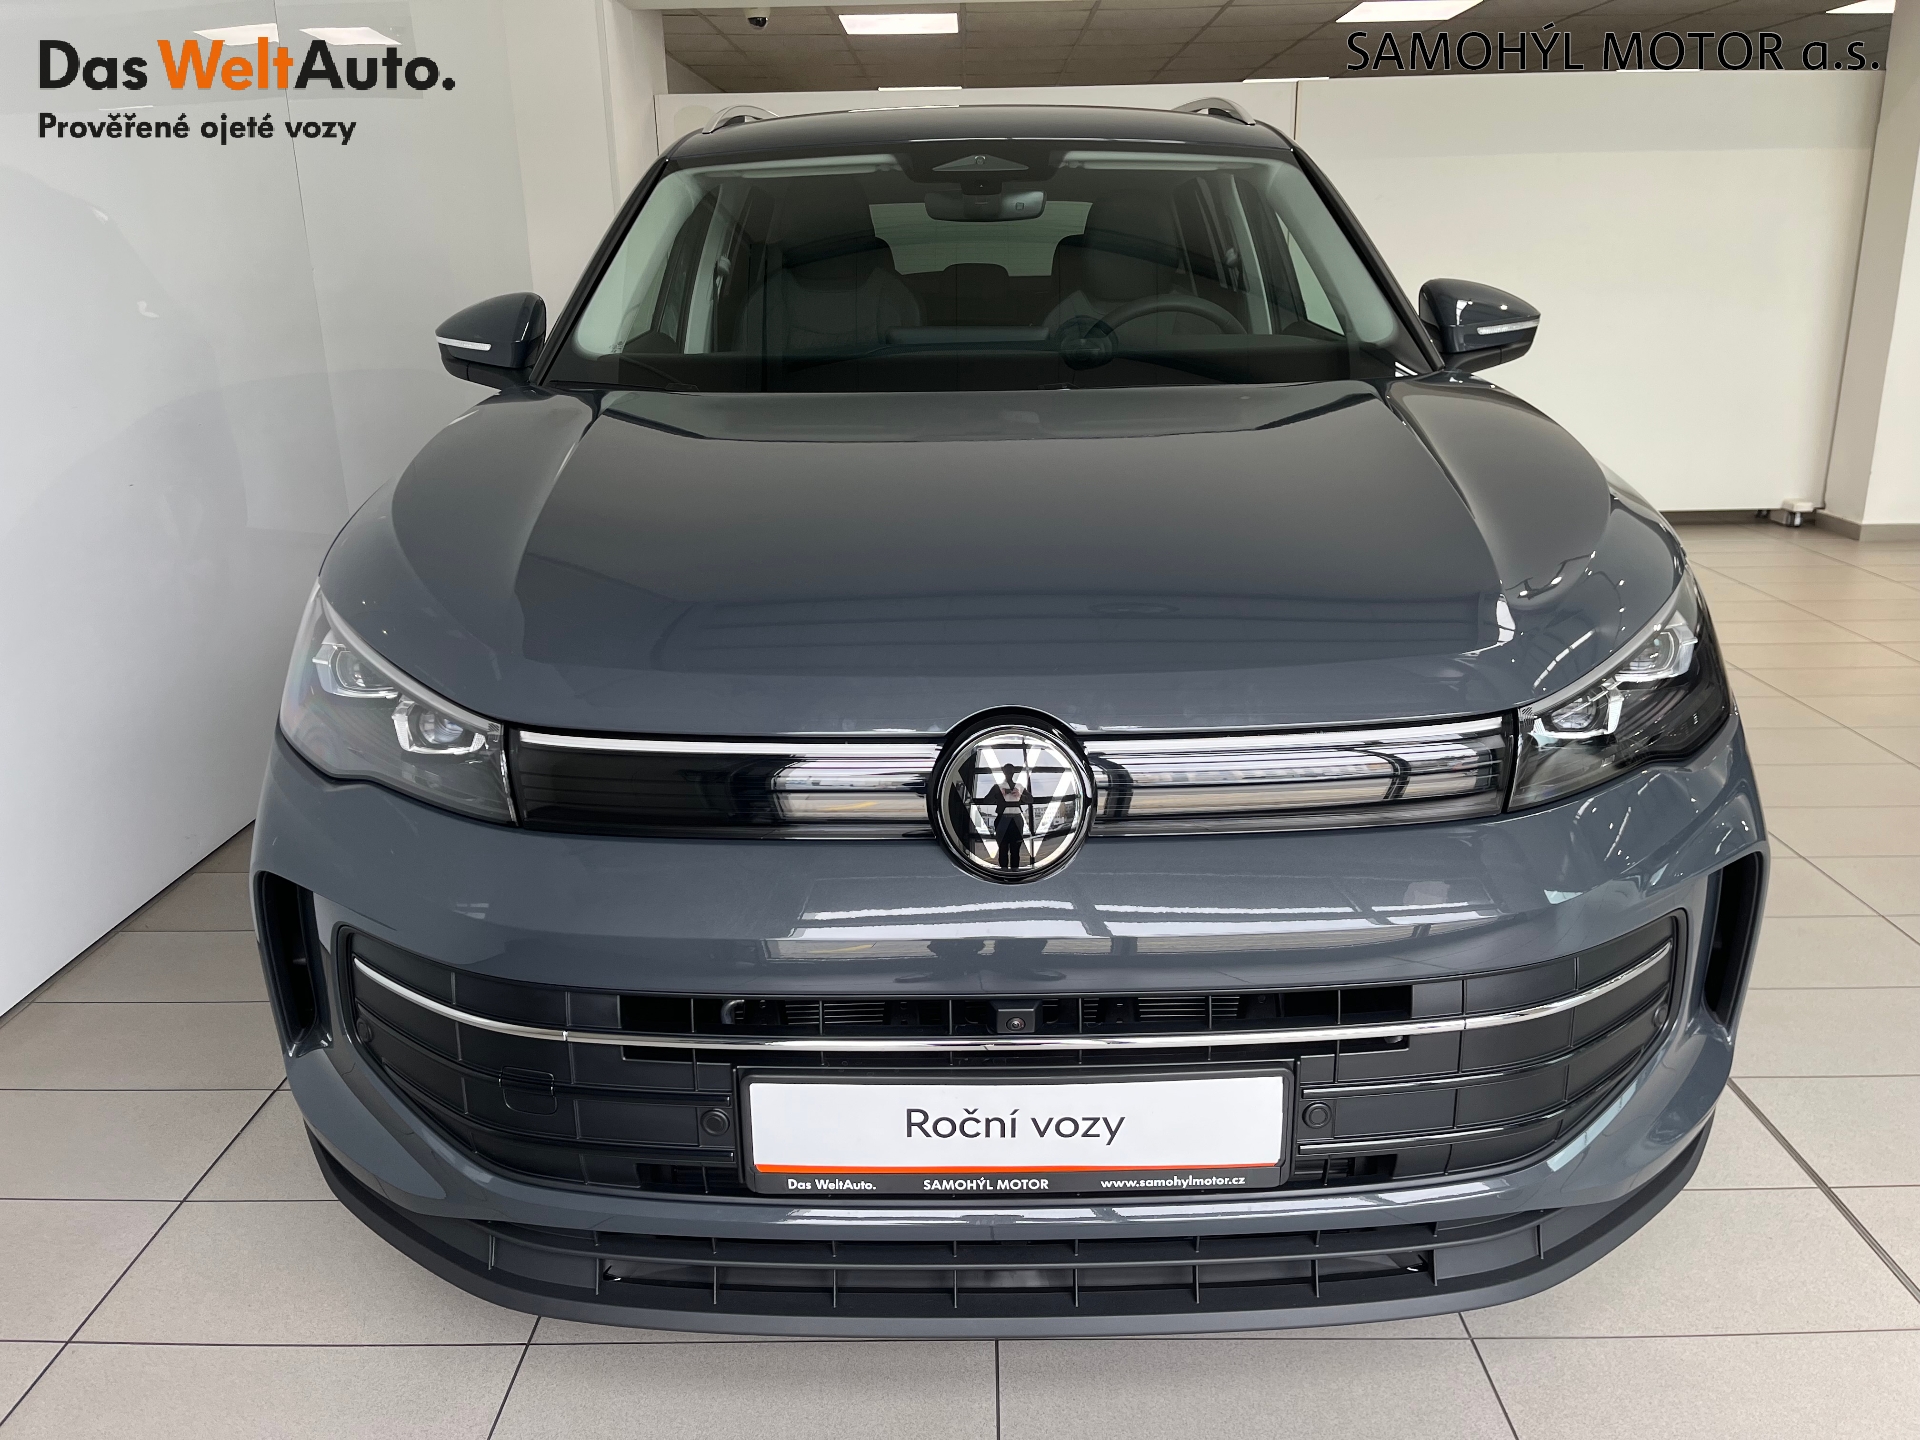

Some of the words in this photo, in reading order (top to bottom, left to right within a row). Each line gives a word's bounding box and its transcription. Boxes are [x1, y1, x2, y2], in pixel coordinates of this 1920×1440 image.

[906, 1108, 1019, 1139] Roční
[1031, 1116, 1126, 1146] vozy
[787, 1178, 812, 1191] Das
[814, 1178, 877, 1191] WeltAuto.
[922, 1176, 994, 1191] SAMOHÝL
[996, 1178, 1050, 1191] MOTOR
[1100, 1174, 1246, 1191] www.samohylmotor.cz
